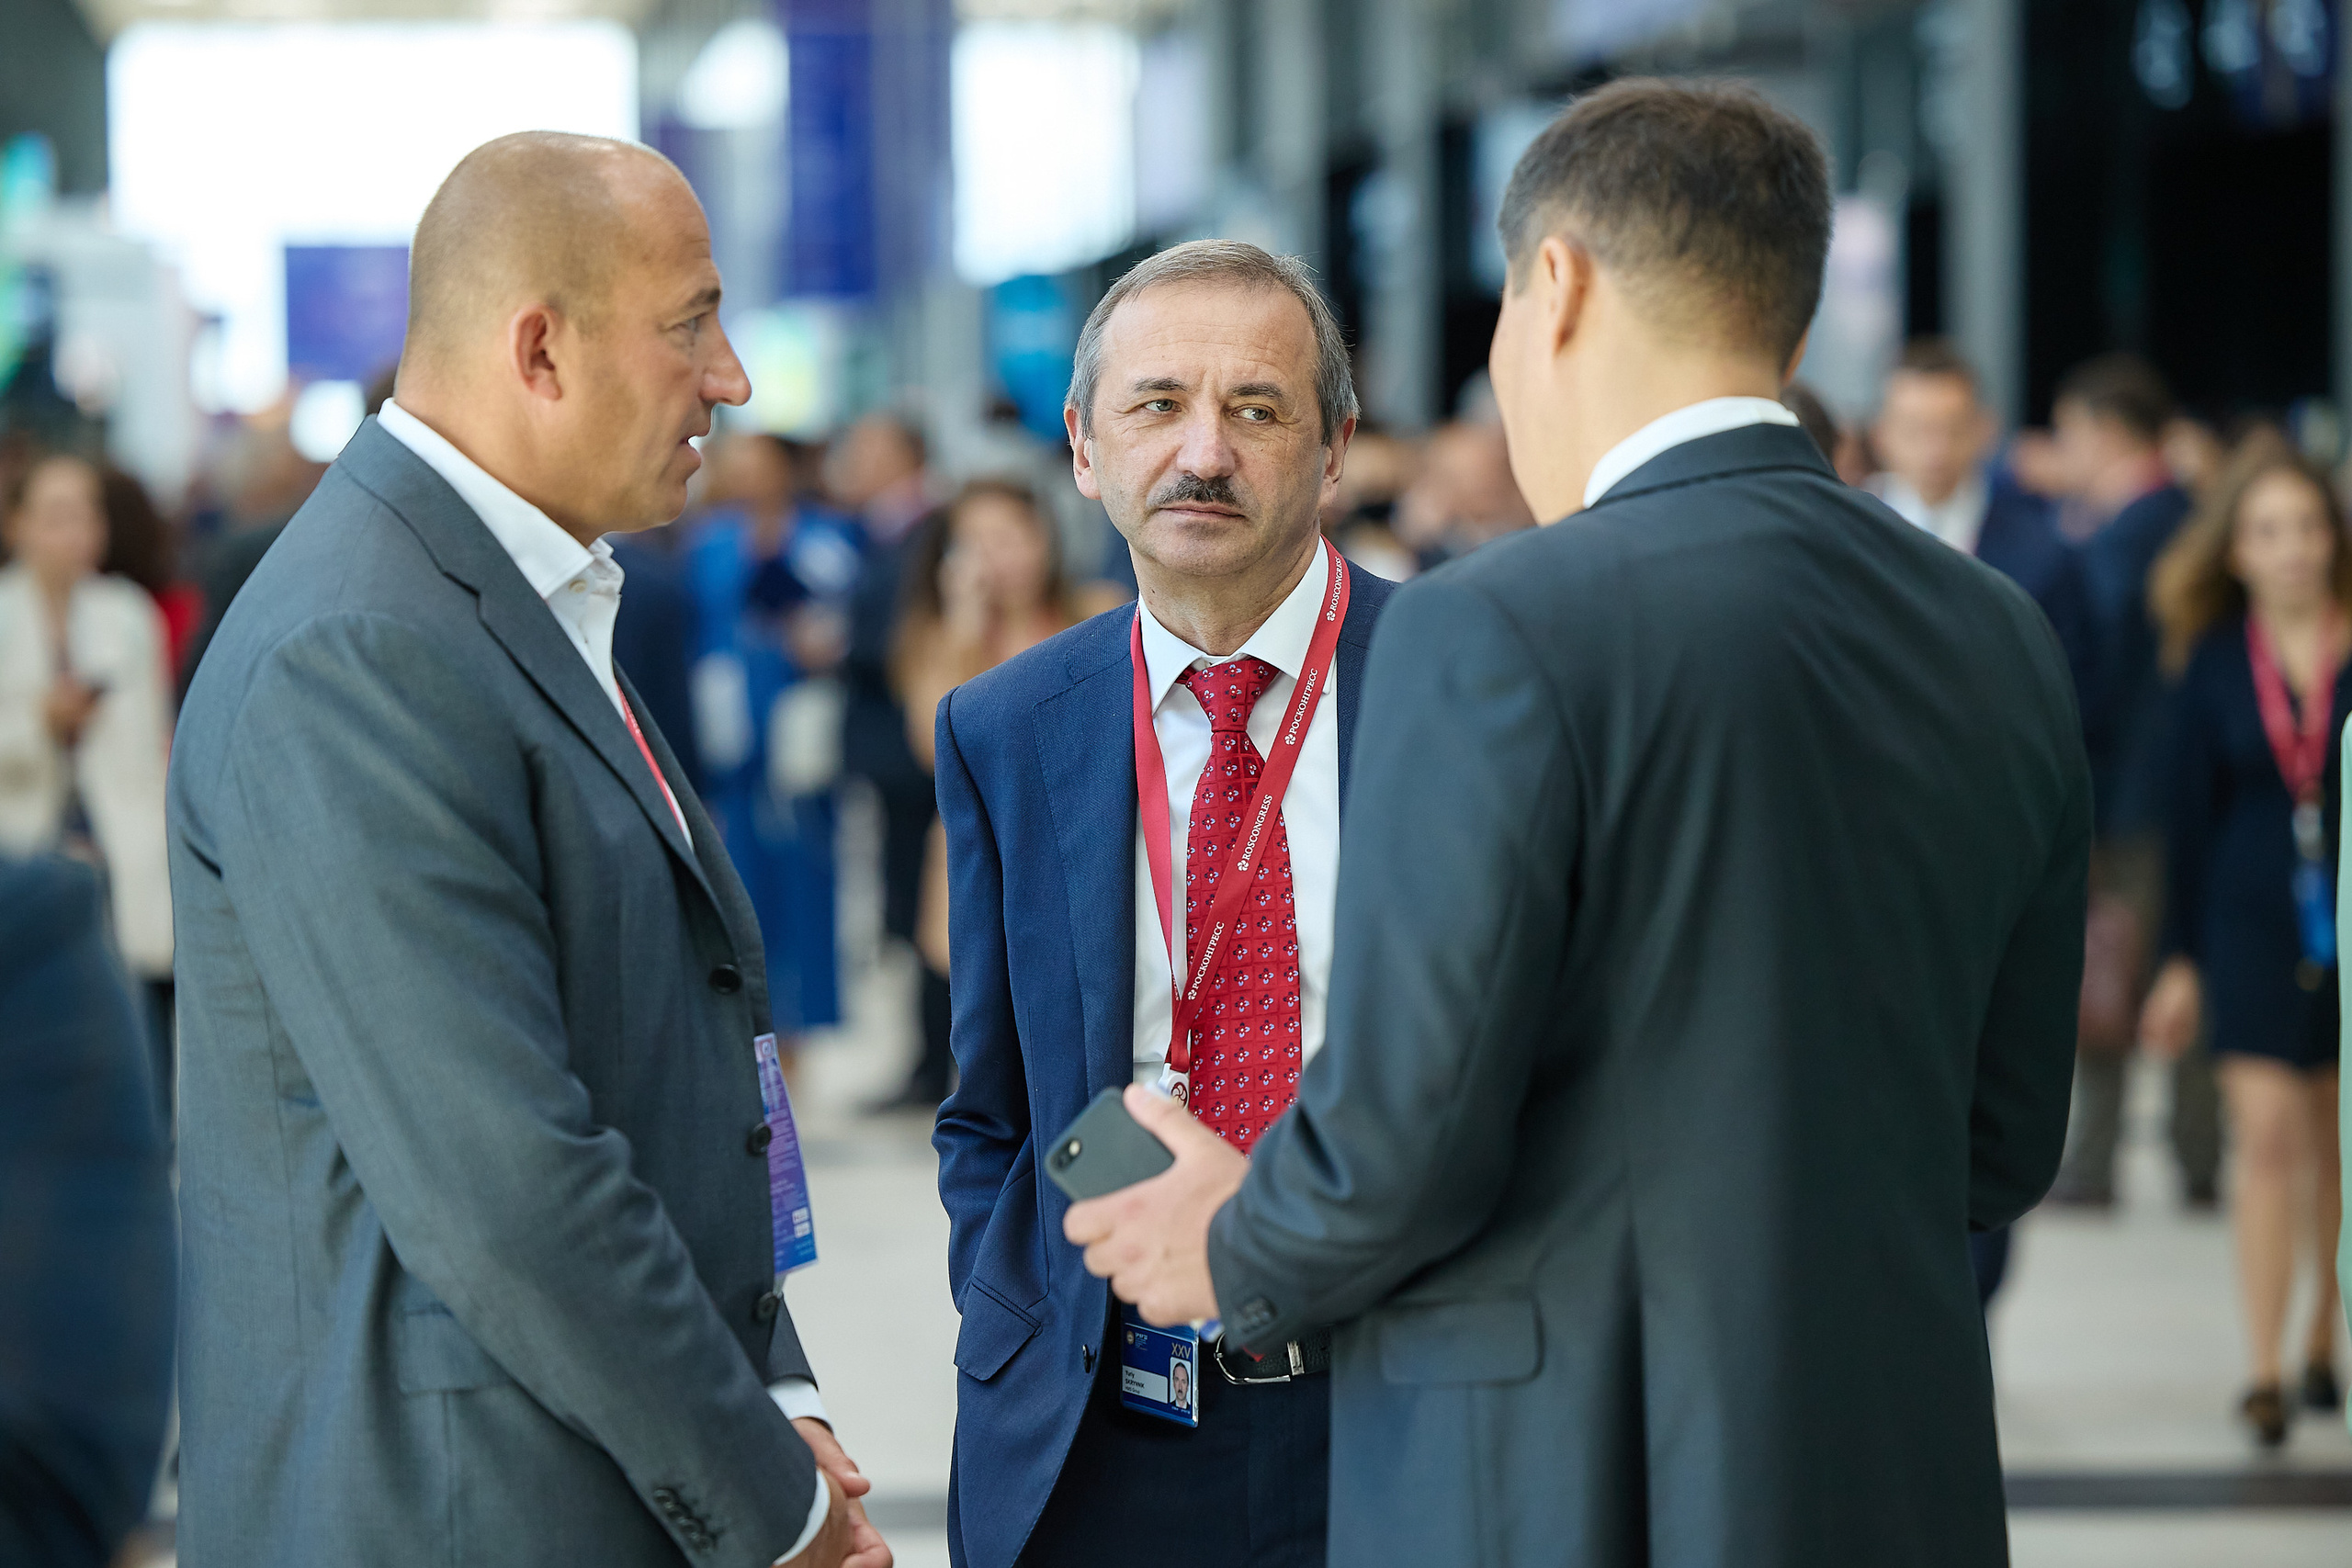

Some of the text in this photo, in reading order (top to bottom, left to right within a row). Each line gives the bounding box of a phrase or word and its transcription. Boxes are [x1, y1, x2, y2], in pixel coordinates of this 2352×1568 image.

[1289, 668, 1318, 735] РОСКОНГРЕСС
[1241, 794, 1272, 861] ROSCONGRESS
[1192, 920, 1225, 999] РОСКОНГРЕСС
[1171, 1343, 1191, 1359] XXV
